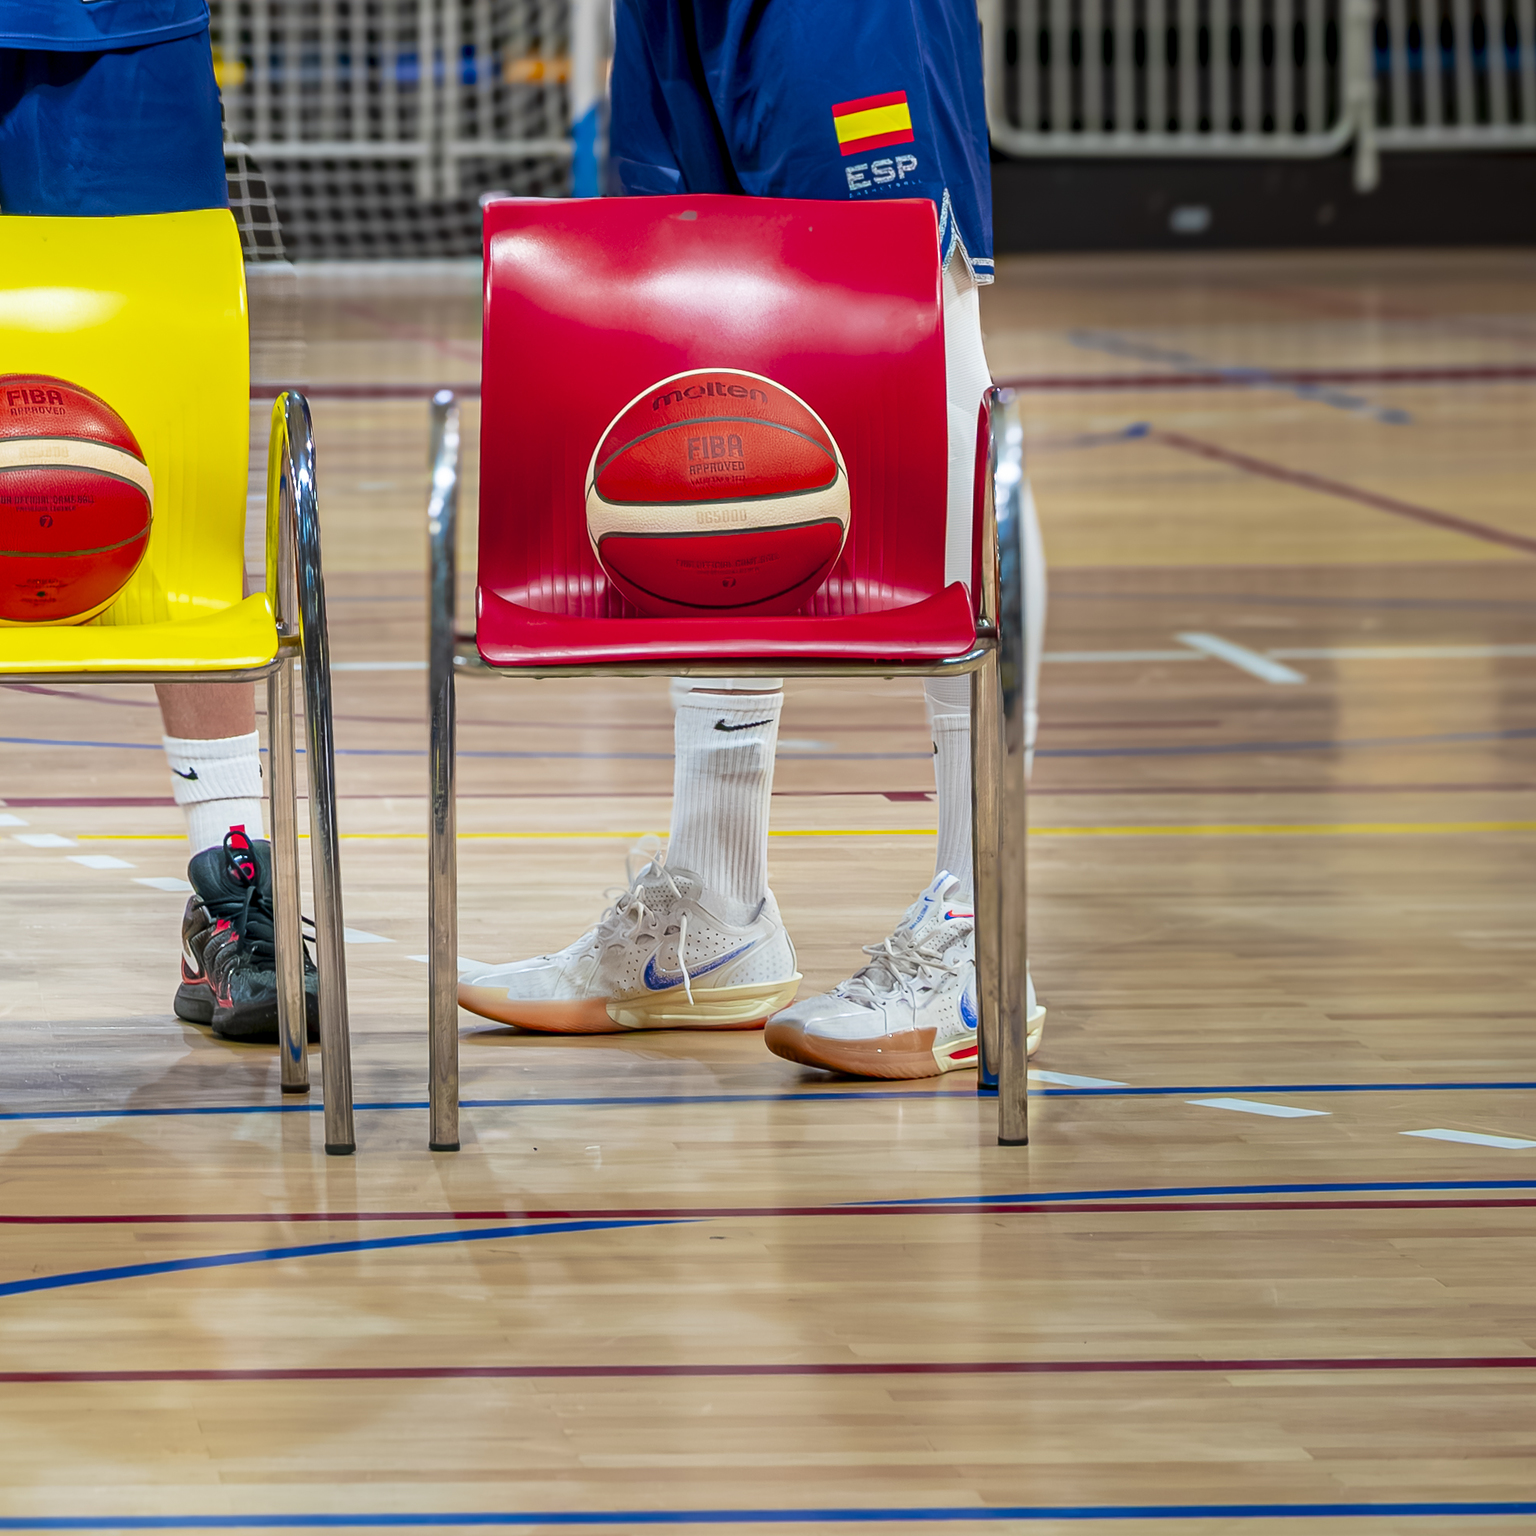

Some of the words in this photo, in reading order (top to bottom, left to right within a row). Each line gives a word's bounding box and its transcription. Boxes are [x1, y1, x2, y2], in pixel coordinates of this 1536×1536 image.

[845, 154, 918, 191] ESP
[6, 388, 64, 407] FIBA
[652, 381, 768, 412] molten
[10, 406, 66, 416] APPROVED
[688, 434, 744, 461] FIBA
[689, 461, 746, 476] APPROVED
